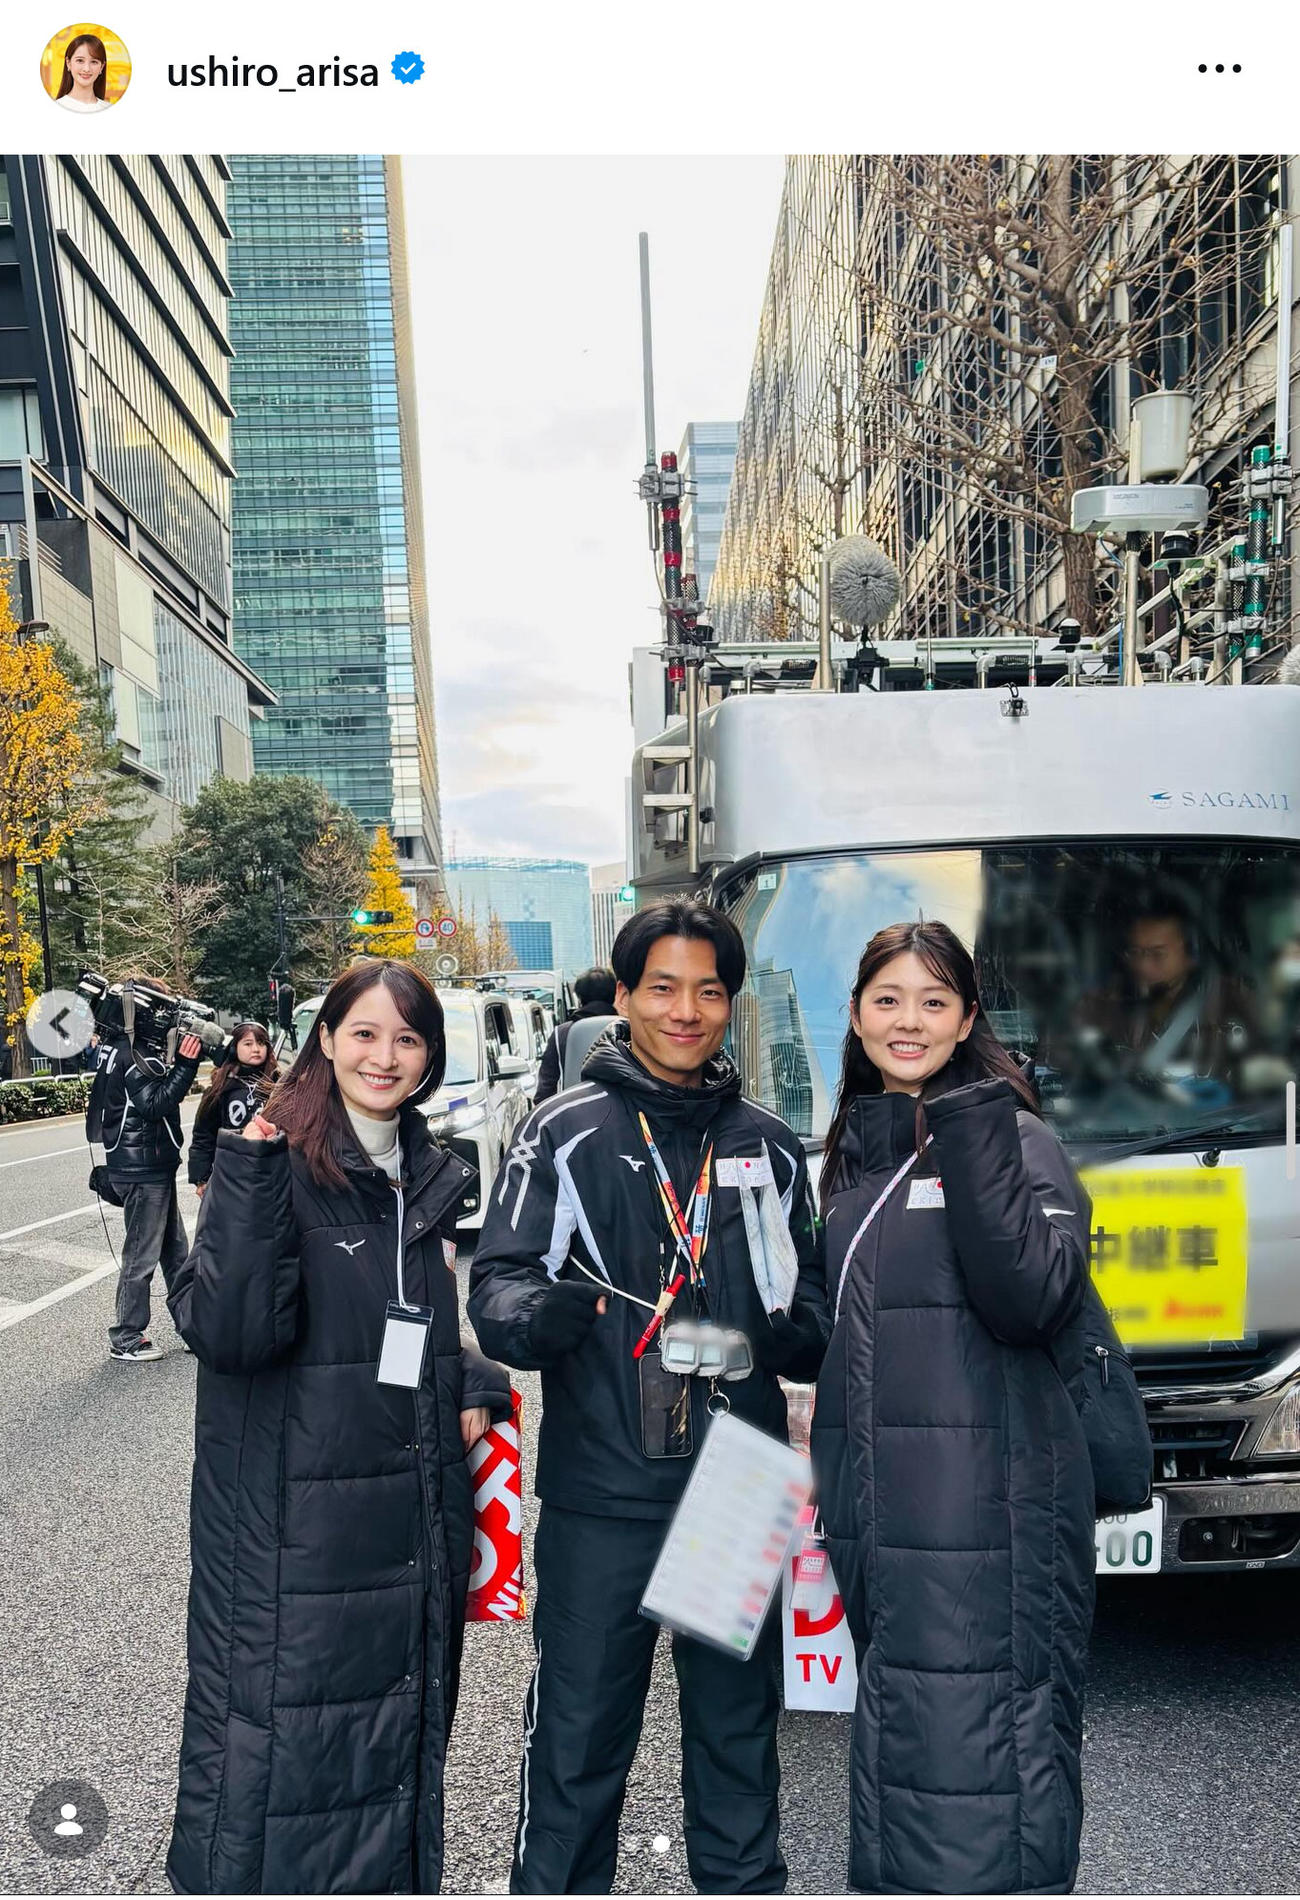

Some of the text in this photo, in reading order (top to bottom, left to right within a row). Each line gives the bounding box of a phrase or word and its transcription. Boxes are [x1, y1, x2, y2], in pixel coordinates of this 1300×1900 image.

[1182, 791, 1290, 811] SAGAMI
[442, 922, 453, 933] 40
[795, 1653, 843, 1684] TV
